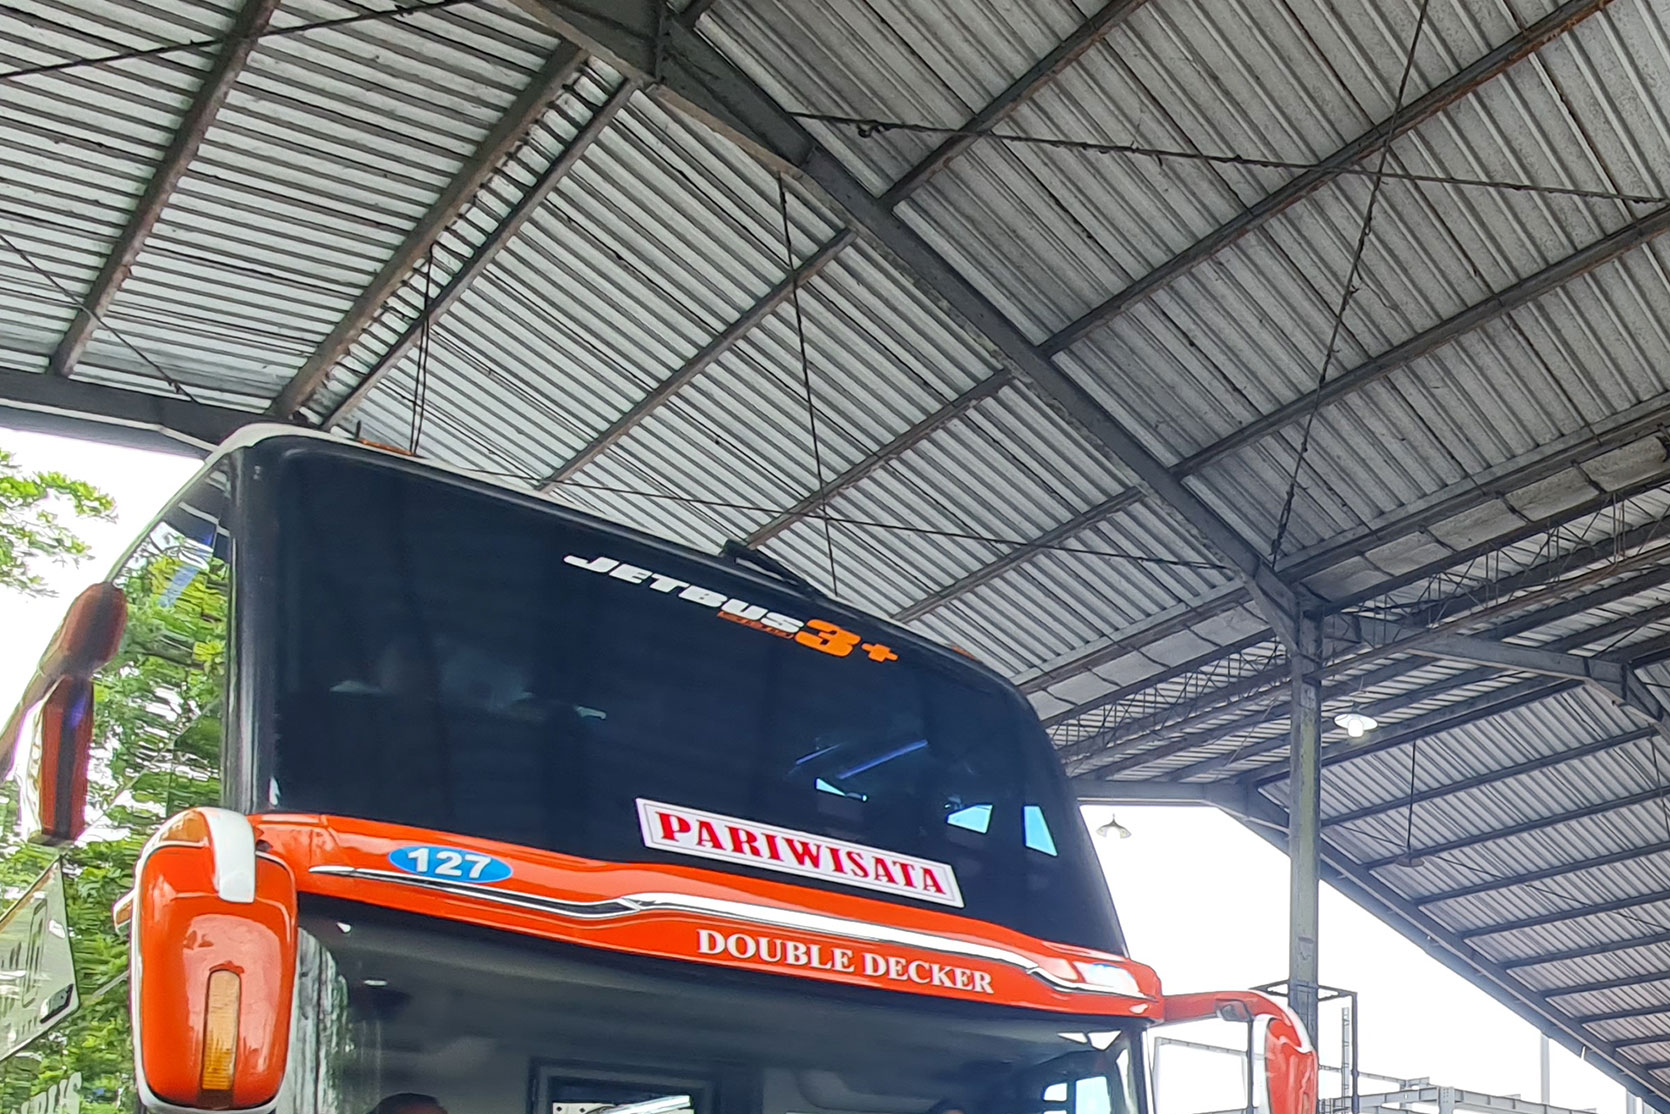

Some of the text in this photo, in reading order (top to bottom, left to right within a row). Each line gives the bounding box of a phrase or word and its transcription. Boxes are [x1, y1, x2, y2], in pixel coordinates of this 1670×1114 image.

[407, 847, 492, 879] 127
[655, 811, 947, 895] PARIWISATA
[696, 929, 994, 995] DOUBLE DECKER
